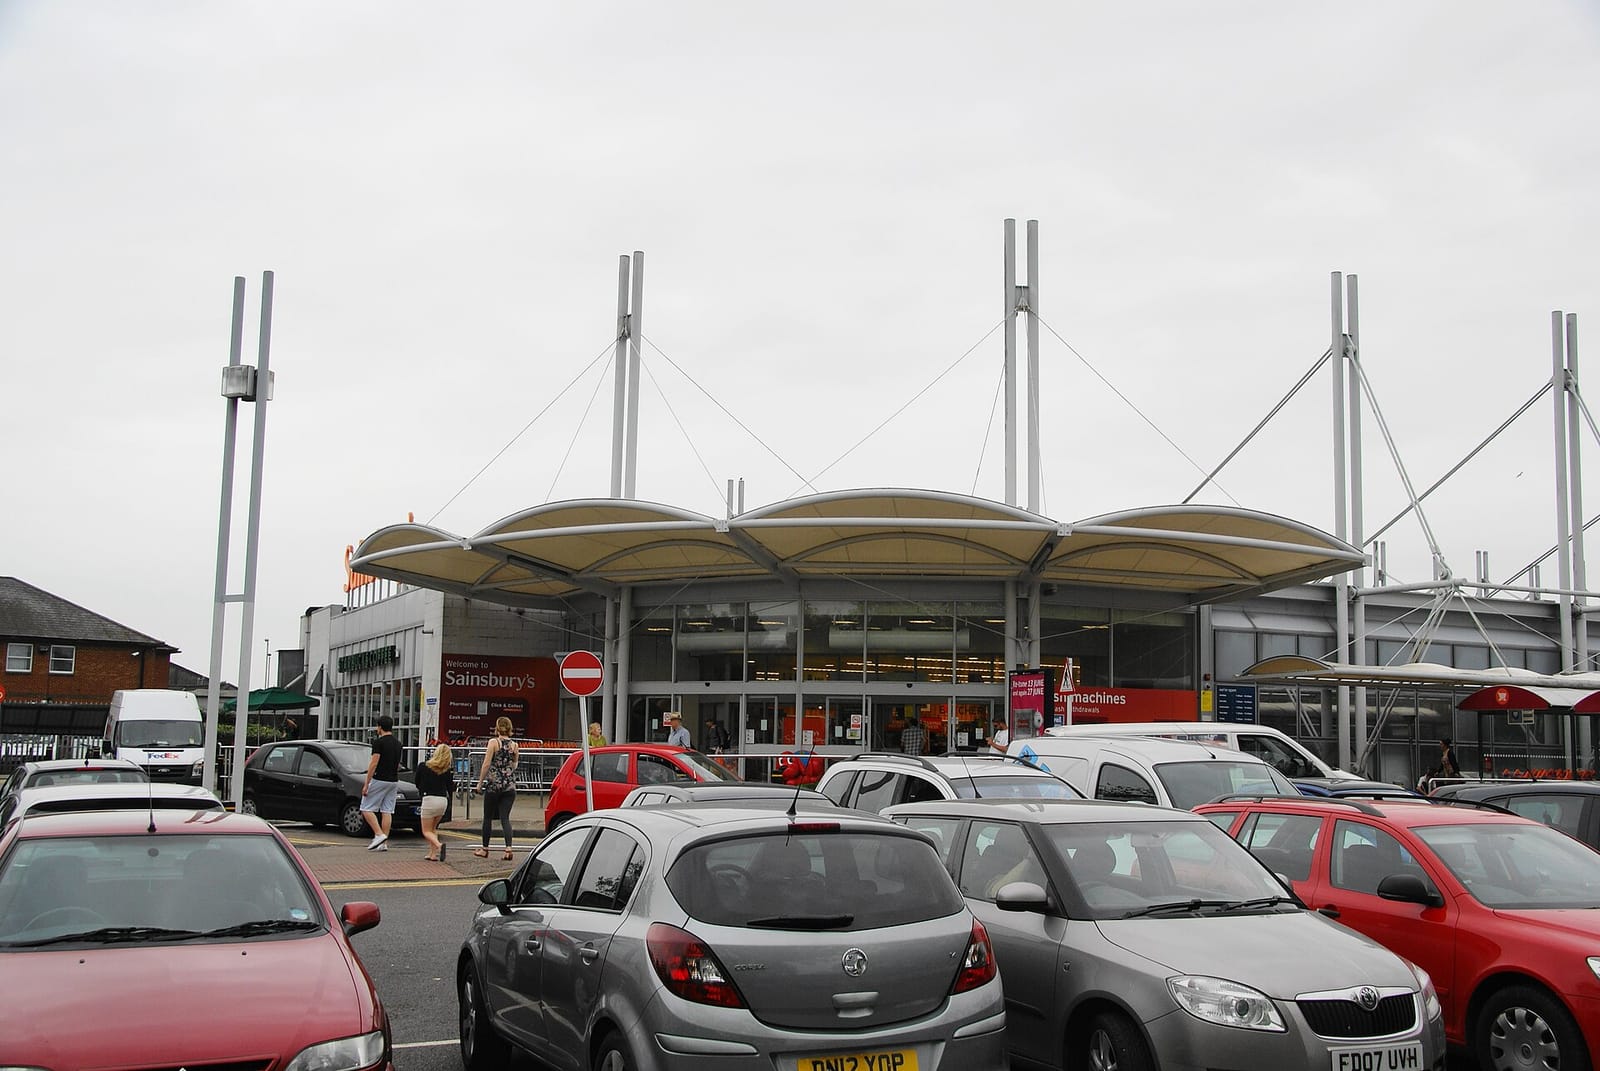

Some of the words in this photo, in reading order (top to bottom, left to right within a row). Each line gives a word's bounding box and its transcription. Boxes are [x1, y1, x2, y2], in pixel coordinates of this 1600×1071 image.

[446, 660, 479, 668] Welcome
[481, 660, 489, 669] to
[445, 670, 536, 691] Sainsbury's
[1028, 679, 1034, 687] 13
[1034, 678, 1045, 688] JUNE
[1027, 687, 1033, 696] 27
[1033, 687, 1044, 697] JUNE
[1072, 692, 1126, 705] machines
[864, 1053, 904, 1071] YOP
[1388, 1047, 1418, 1070] UVH
